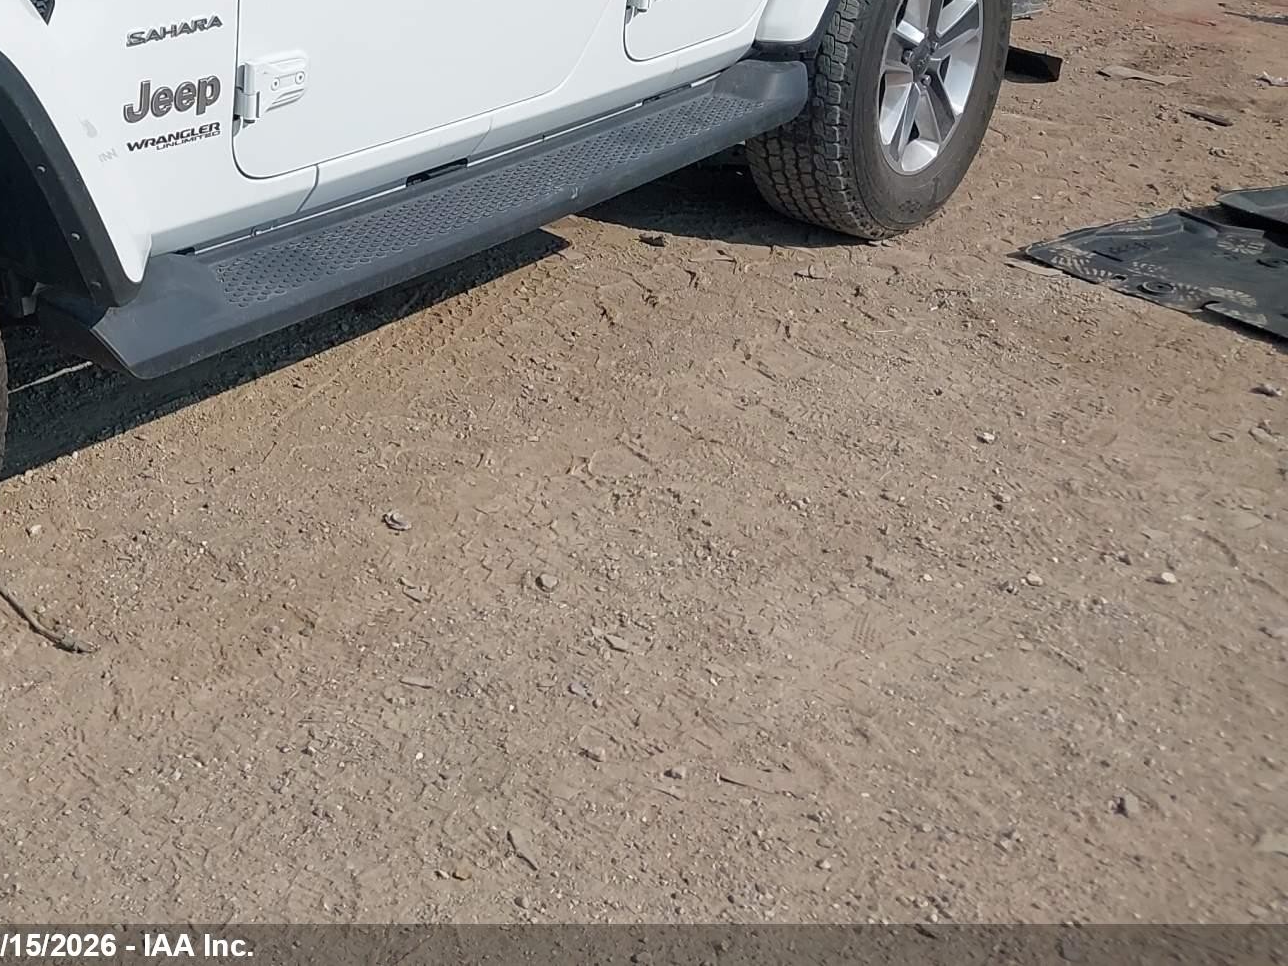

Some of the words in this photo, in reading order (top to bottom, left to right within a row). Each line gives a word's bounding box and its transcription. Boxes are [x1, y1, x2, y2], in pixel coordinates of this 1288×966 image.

[126, 15, 223, 47] SAHARA
[123, 75, 221, 123] Jeep
[126, 121, 221, 151] WRANGLER
[156, 130, 221, 150] UNLIMITED
